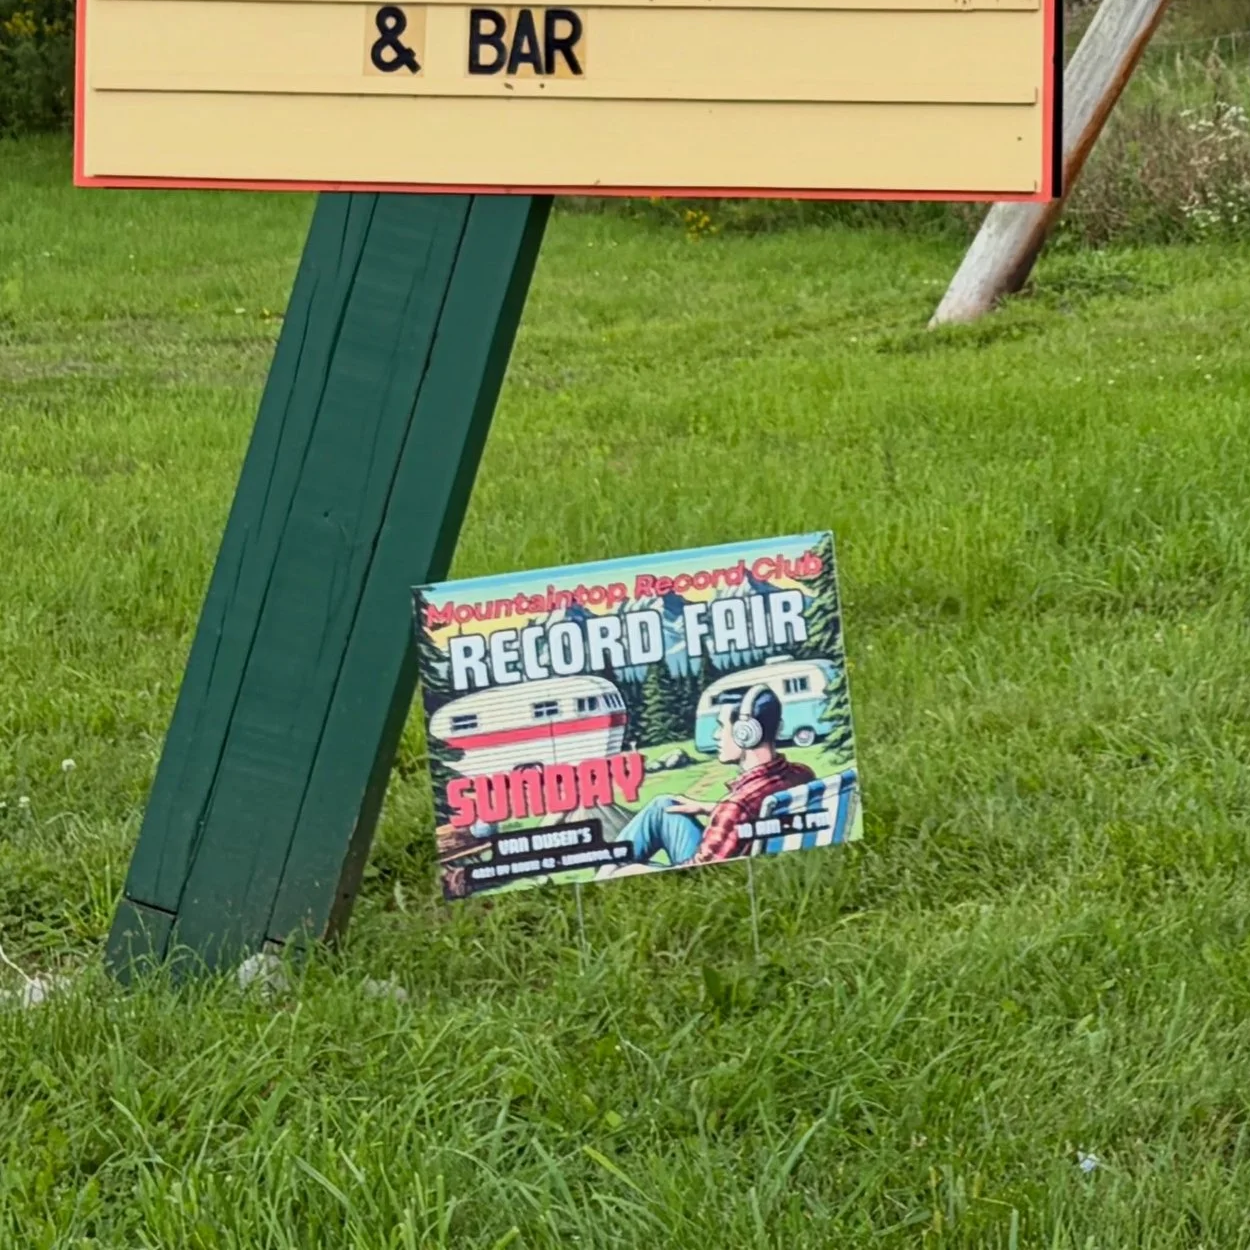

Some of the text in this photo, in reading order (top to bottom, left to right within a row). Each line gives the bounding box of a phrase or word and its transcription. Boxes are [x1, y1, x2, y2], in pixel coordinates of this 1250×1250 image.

[371, 6, 583, 75] & BAR
[426, 550, 823, 629] Mountaintop Record Club
[450, 590, 807, 691] RECORD FAIR
[446, 753, 644, 828] SUNDAY
[498, 827, 593, 855] VAN DUSEN'S
